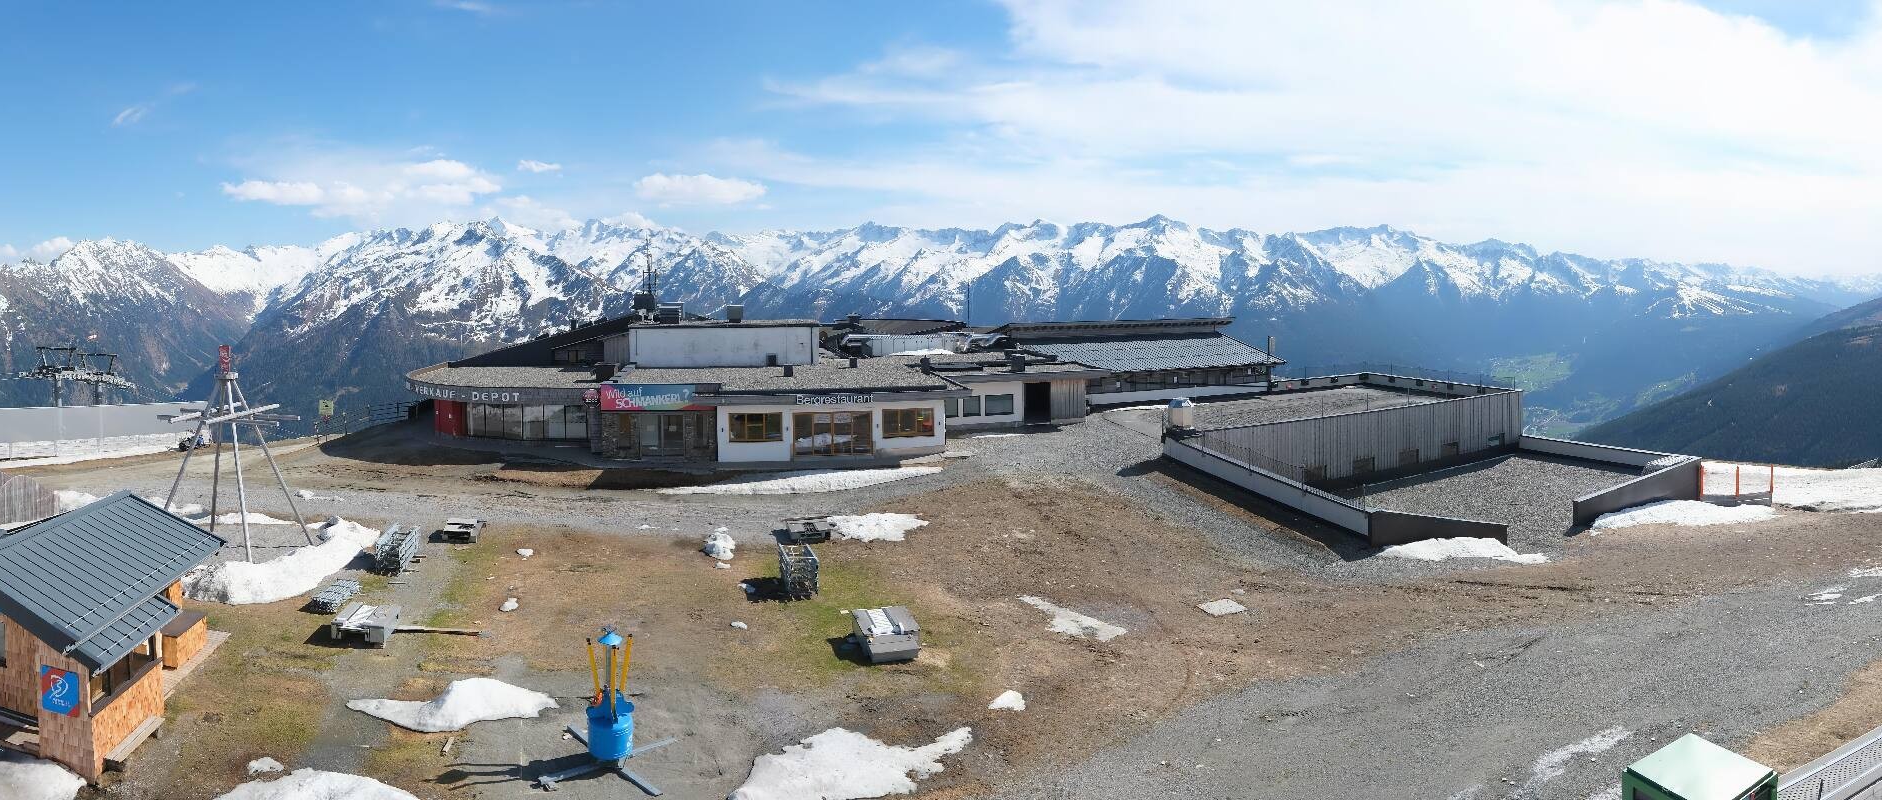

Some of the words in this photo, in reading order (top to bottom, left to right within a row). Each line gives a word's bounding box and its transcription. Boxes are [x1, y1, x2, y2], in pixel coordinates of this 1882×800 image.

[415, 385, 456, 399] VERKAUF
[472, 391, 520, 402] DEPOT
[606, 387, 626, 399] Wild
[628, 386, 643, 397] auf
[796, 394, 874, 406] Bergrestaurant
